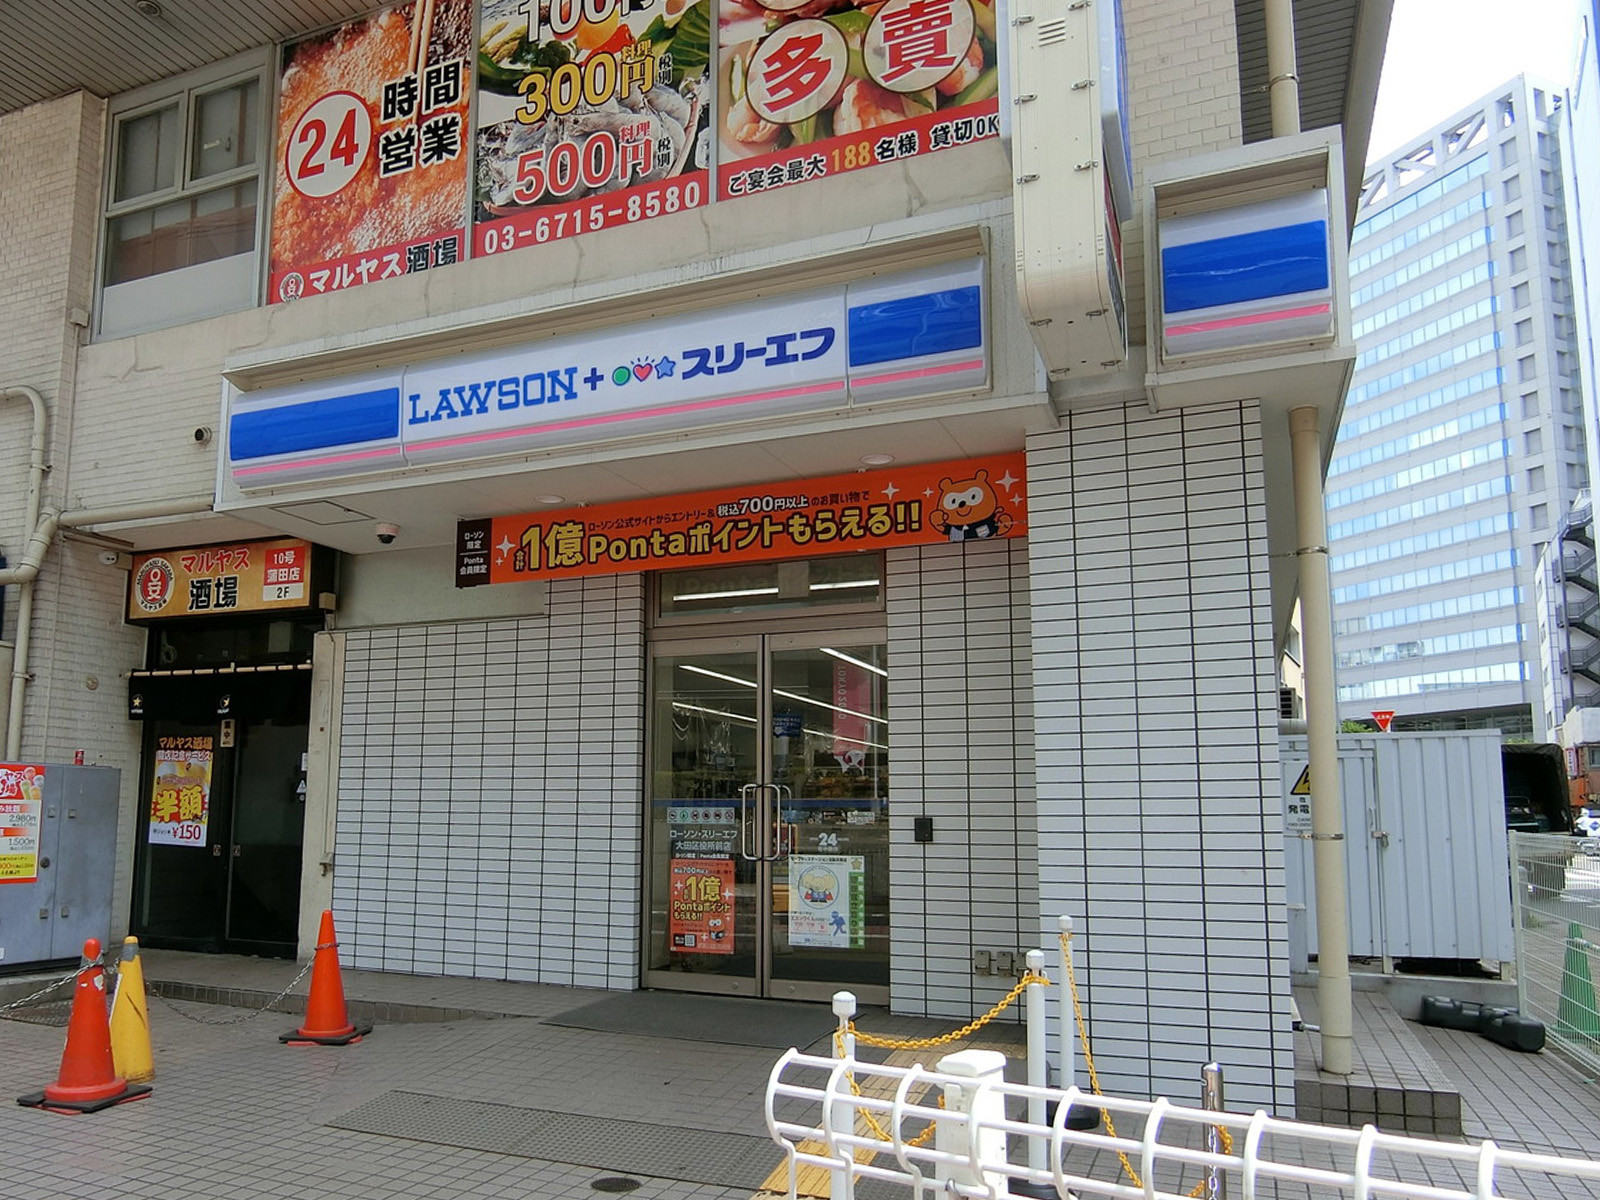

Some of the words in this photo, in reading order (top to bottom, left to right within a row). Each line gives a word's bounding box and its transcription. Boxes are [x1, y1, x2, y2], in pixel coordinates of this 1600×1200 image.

[382, 64, 462, 120] 時間
[297, 108, 360, 181] 24
[381, 118, 462, 176] 営業
[485, 182, 700, 253] 03-6715-8580
[309, 236, 457, 292] マルヤス酒場
[682, 326, 836, 380] スリーエフ
[408, 367, 578, 425] LAWSON
[181, 549, 250, 574] マルヤス
[273, 550, 296, 565] 10号
[189, 576, 239, 611] 酒場
[276, 586, 290, 599] 2F
[172, 824, 202, 840] ¥150
[818, 832, 838, 846] 24
